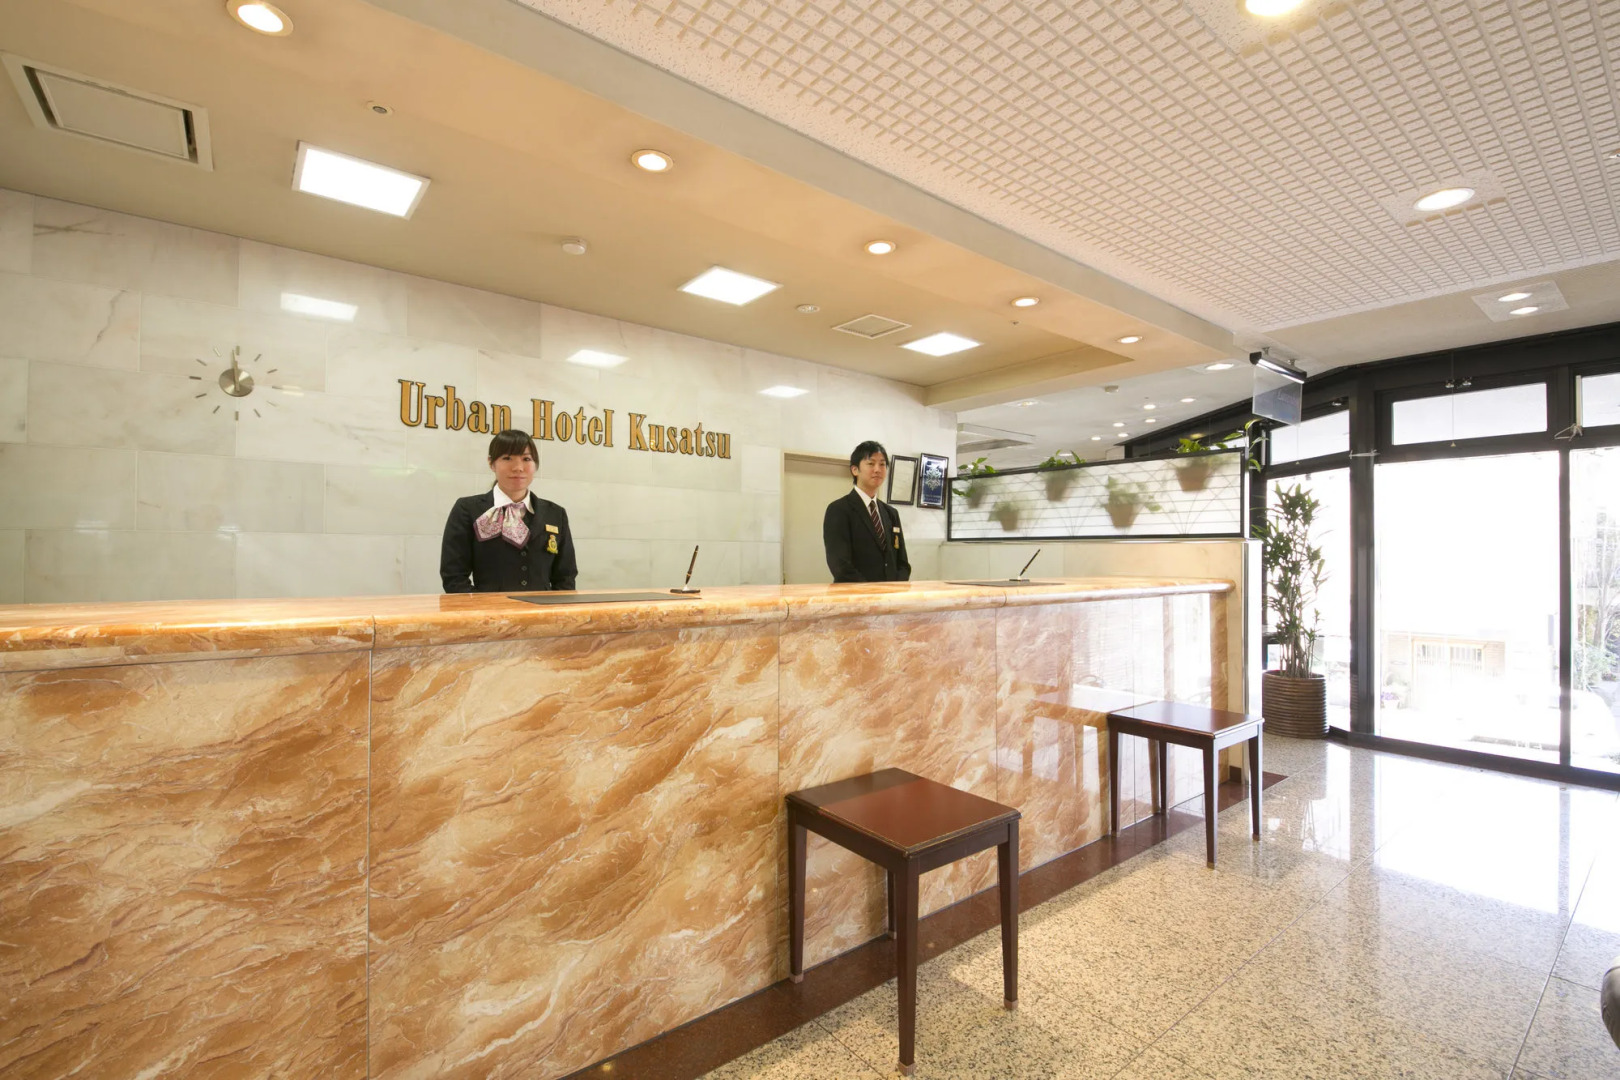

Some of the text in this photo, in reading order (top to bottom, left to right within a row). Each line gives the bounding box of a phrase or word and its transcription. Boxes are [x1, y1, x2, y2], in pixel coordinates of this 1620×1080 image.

[398, 379, 731, 459] Urban Hotel Kusatsu
